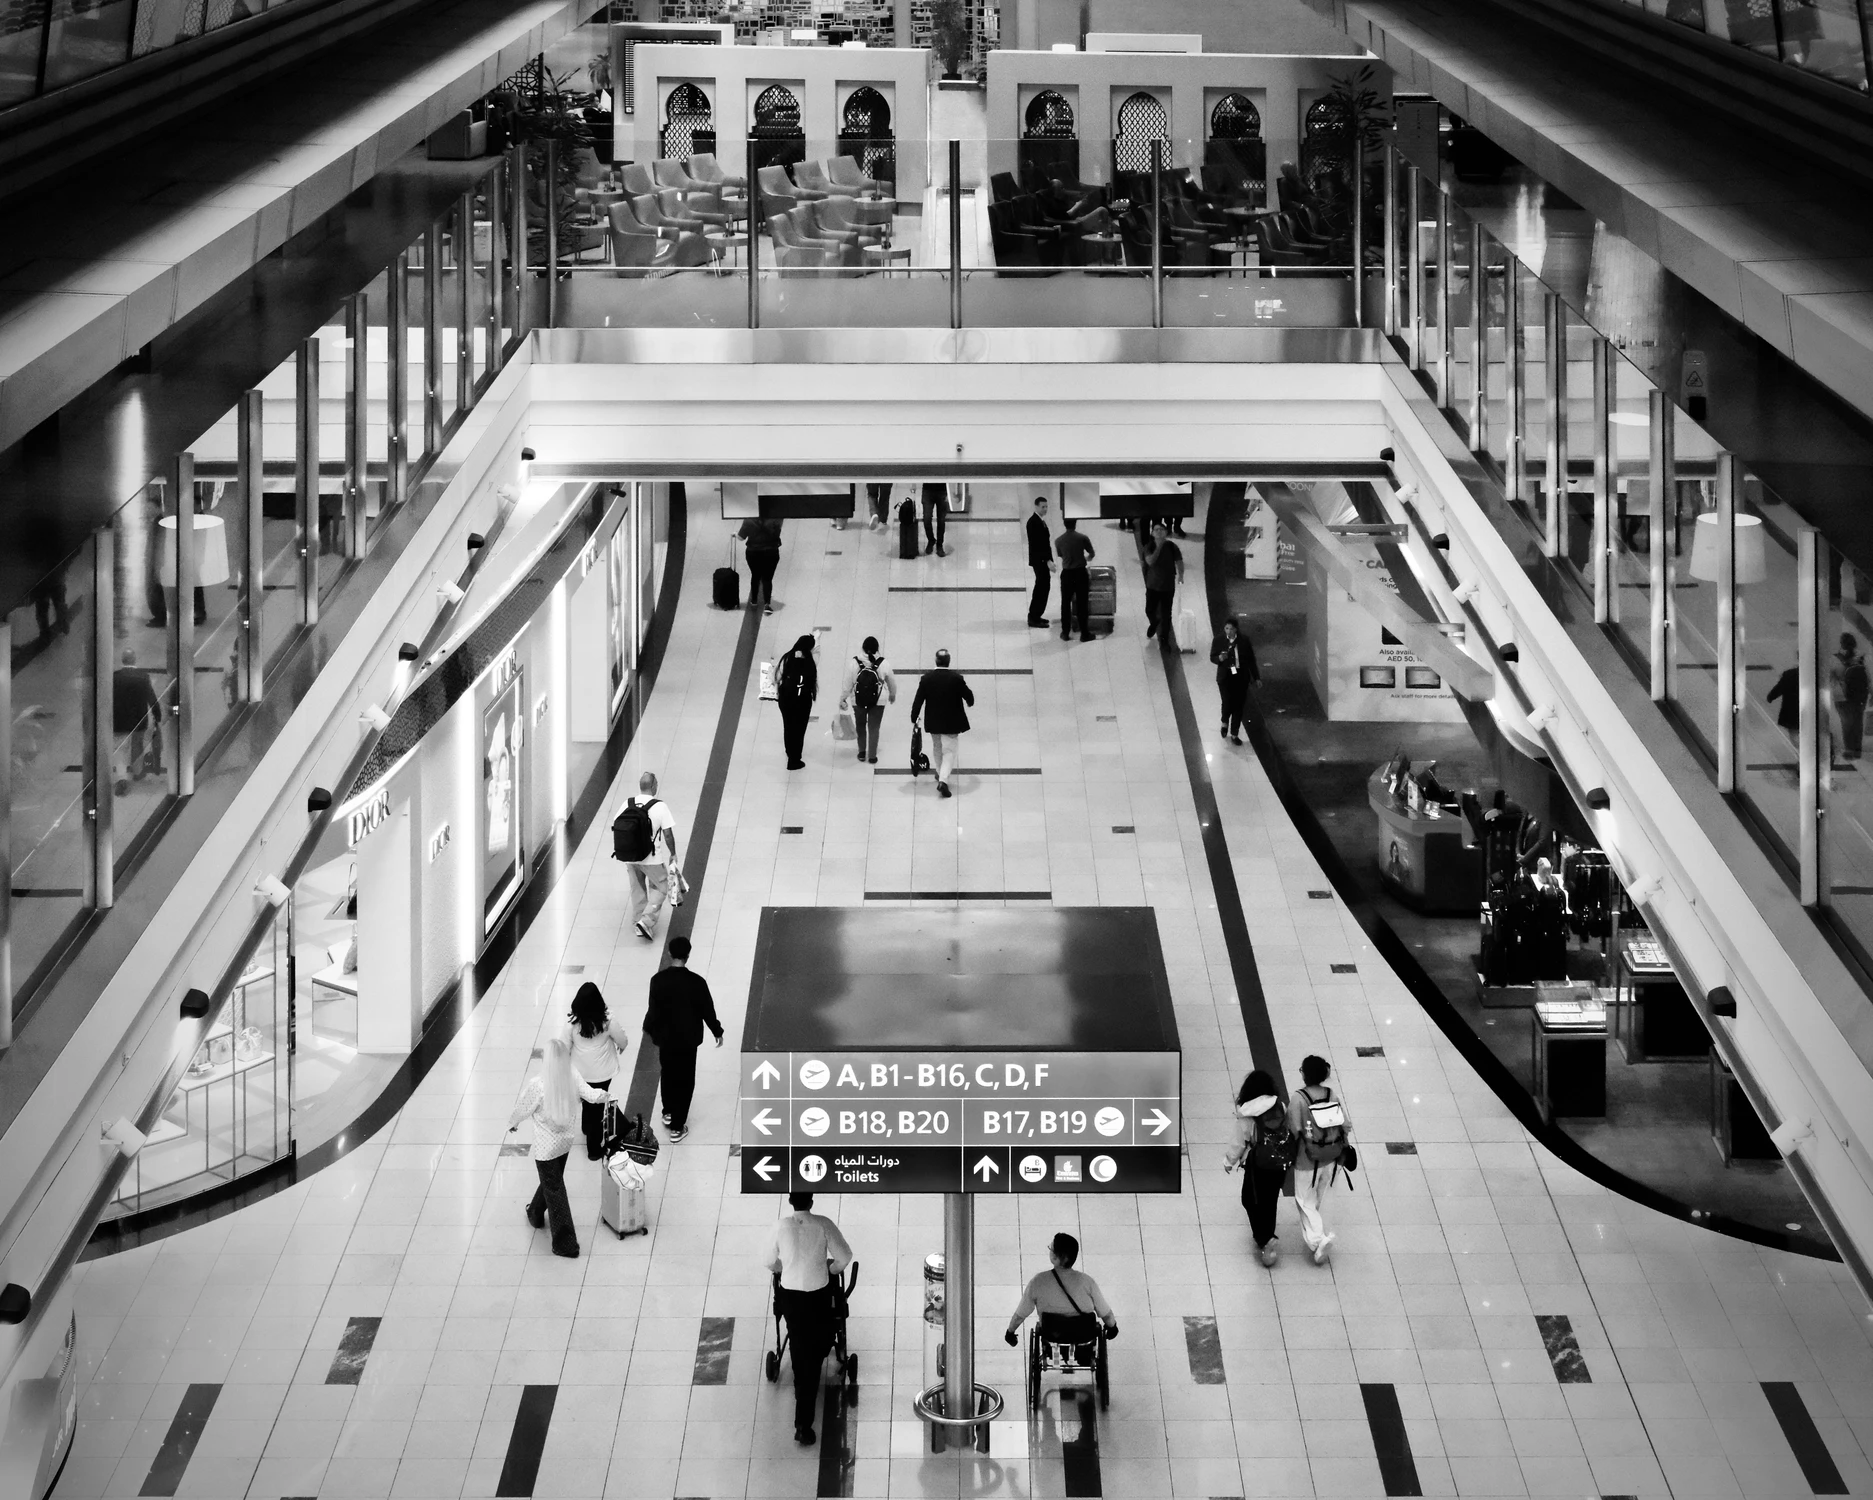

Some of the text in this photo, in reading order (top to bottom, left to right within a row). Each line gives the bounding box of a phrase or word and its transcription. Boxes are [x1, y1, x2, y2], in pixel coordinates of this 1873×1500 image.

[351, 789, 391, 846] DIOR
[834, 1154, 900, 1168] دورات المياه
[834, 1170, 880, 1183] Toilets
